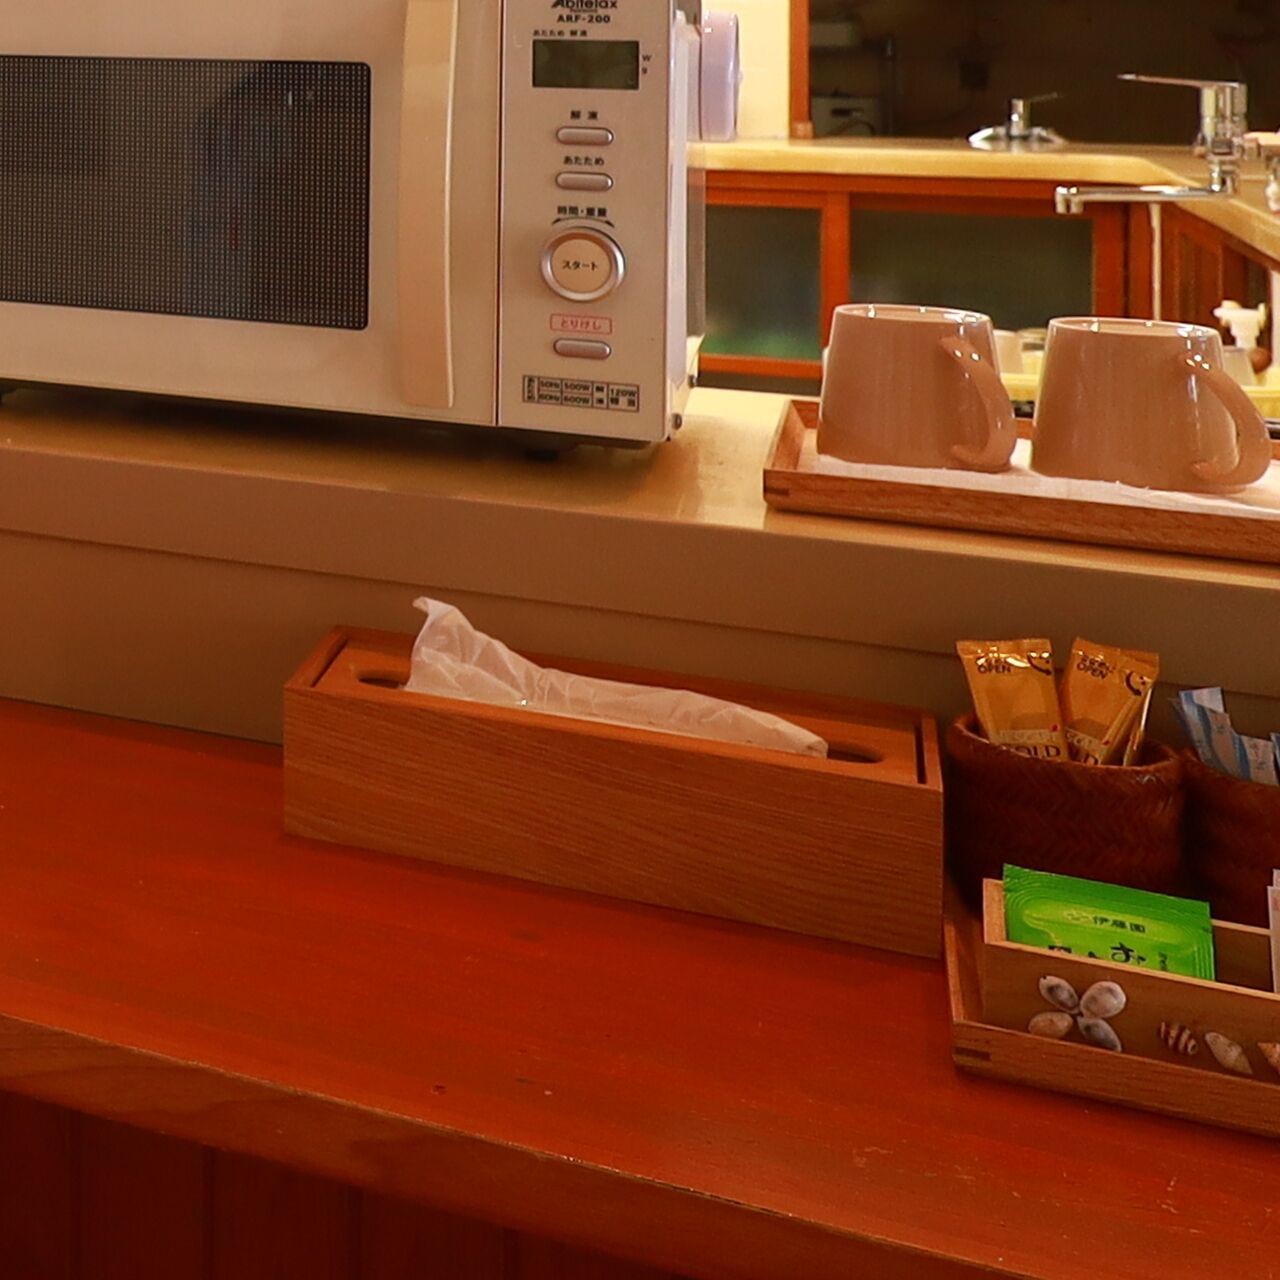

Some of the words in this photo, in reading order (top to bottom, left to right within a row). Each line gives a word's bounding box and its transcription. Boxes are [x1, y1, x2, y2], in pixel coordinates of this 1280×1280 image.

[556, 14, 611, 24] ARF-200
[561, 260, 599, 272] スタート
[560, 318, 602, 331] とりけし
